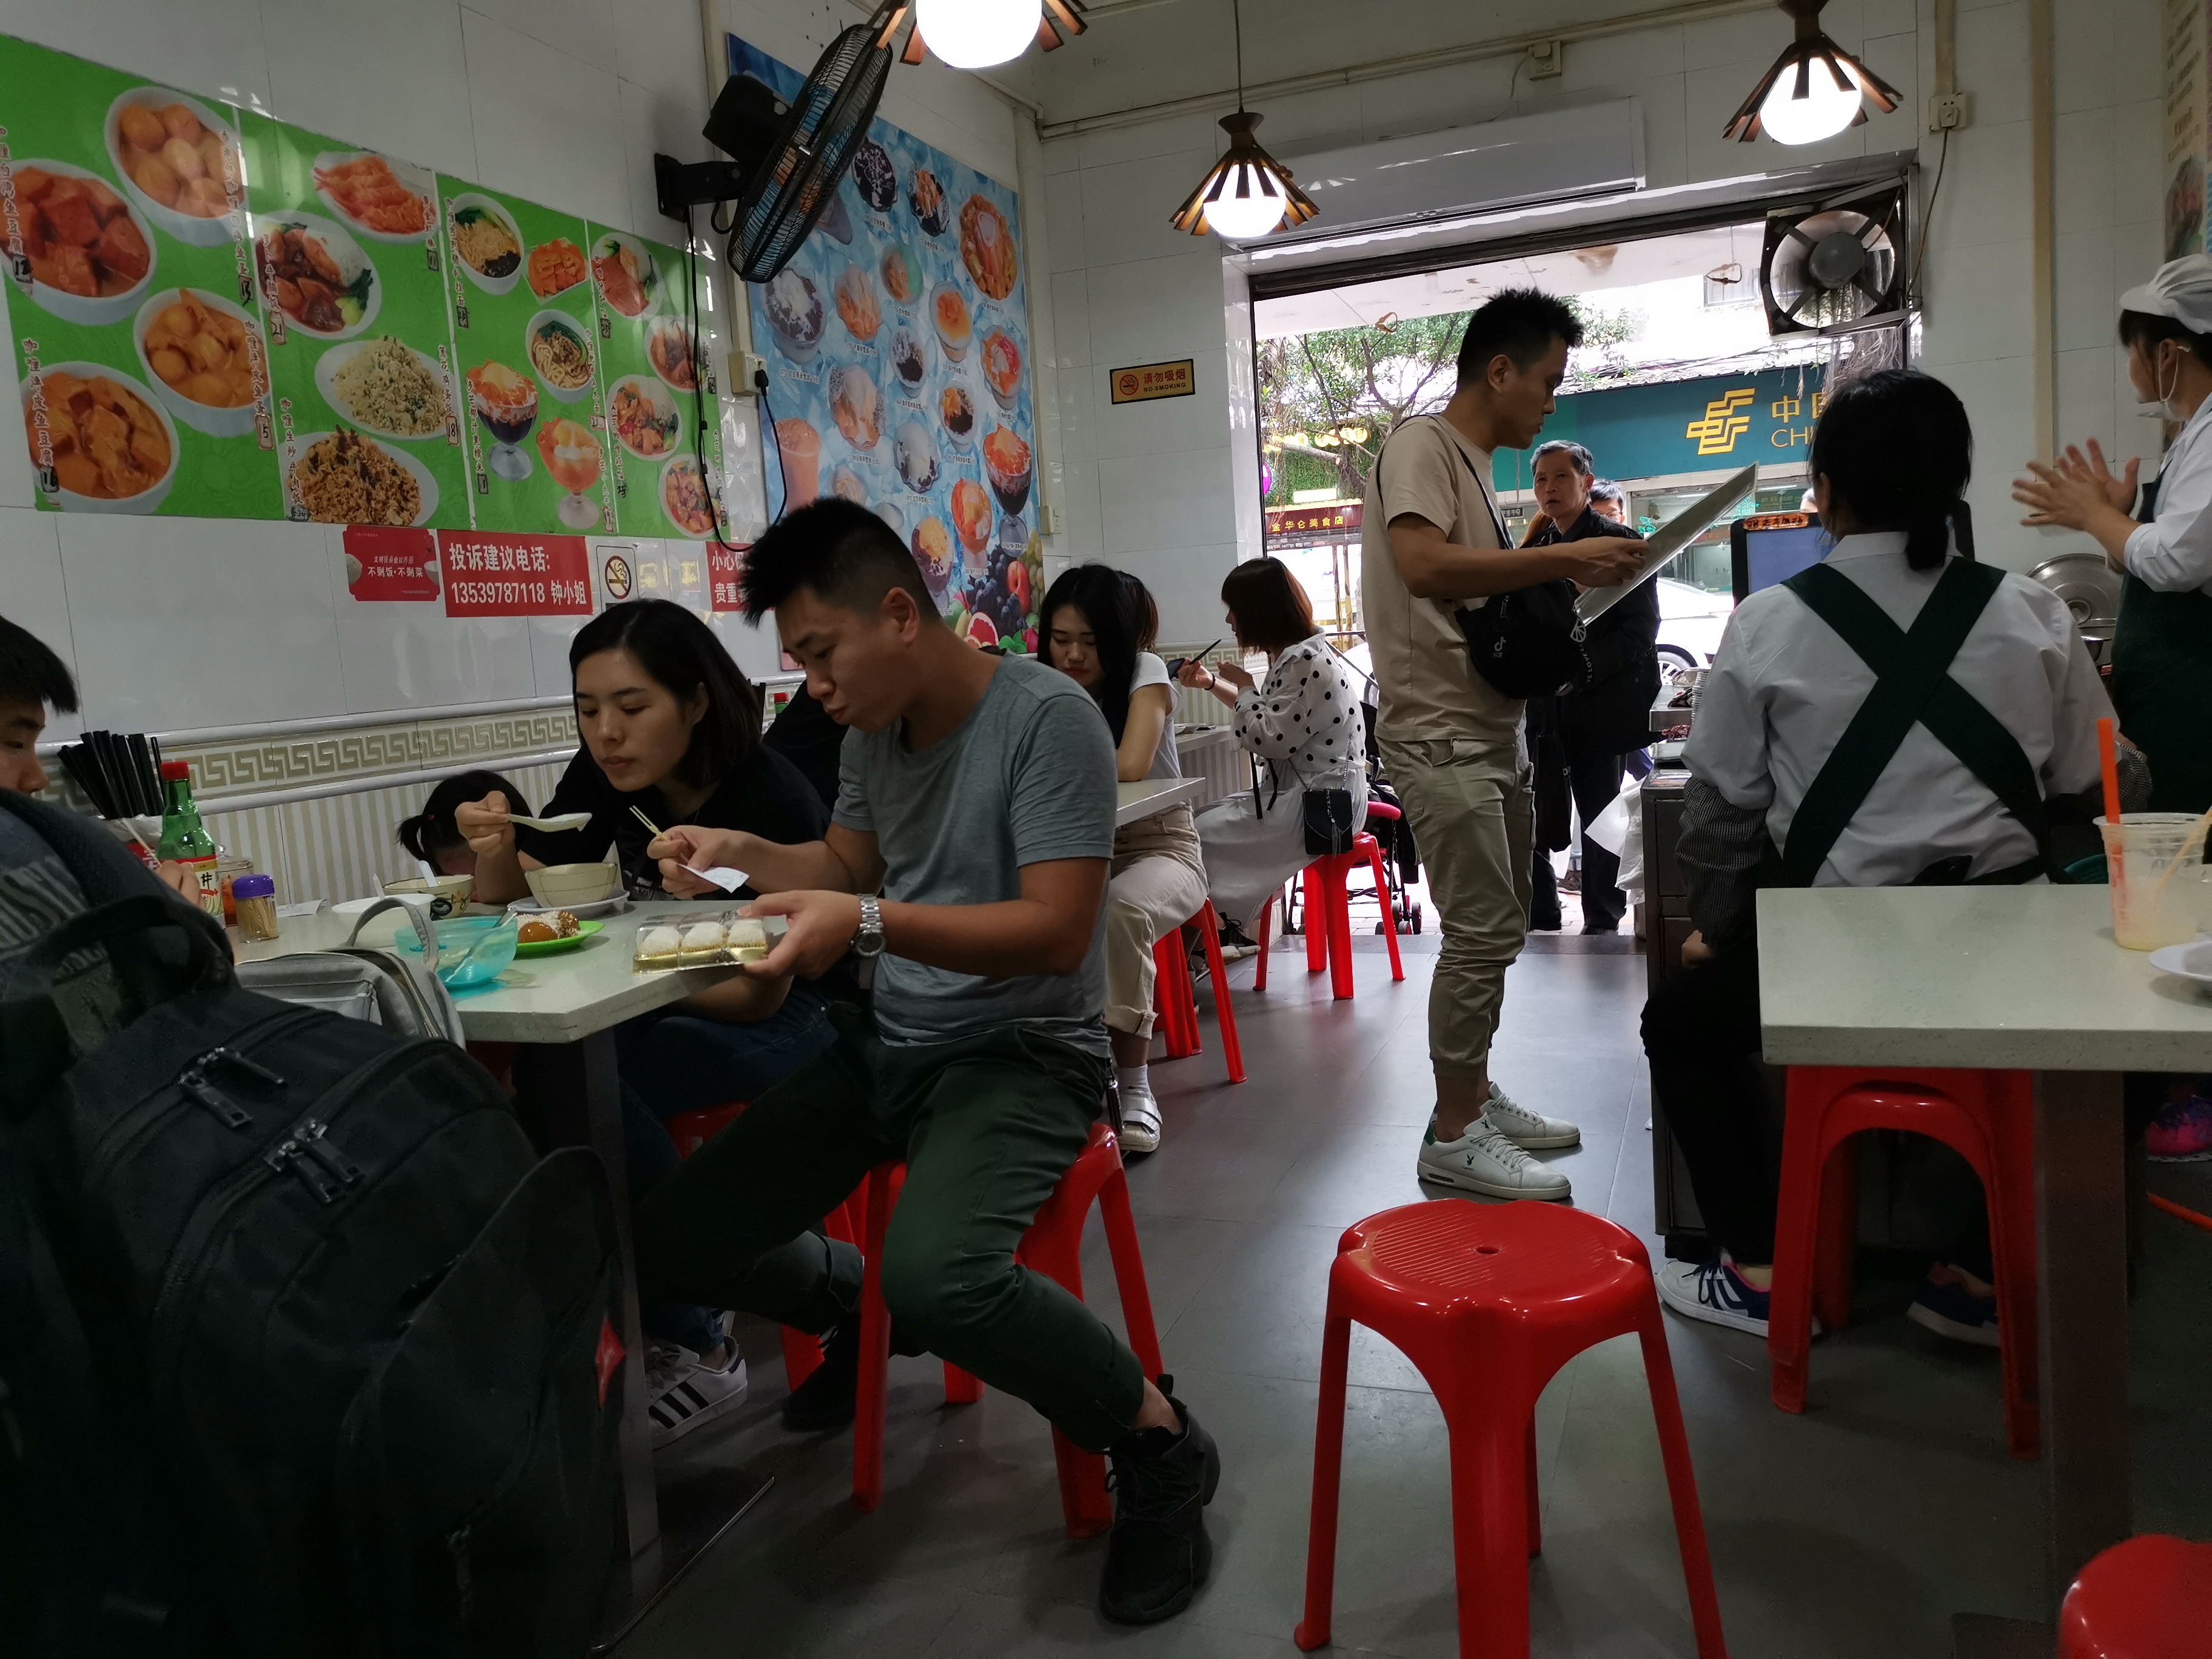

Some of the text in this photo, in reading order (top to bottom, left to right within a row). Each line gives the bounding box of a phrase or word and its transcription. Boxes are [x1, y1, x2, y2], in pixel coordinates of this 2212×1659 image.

[1144, 368, 1186, 384] 请勿吸烟
[1155, 382, 1186, 390] SMOKING
[258, 423, 269, 438] 15
[447, 423, 456, 438] 18
[280, 398, 304, 506] 咖喱生炒牛肉饭
[1272, 515, 1344, 532] 金华仑美食店
[451, 578, 587, 605] 13539787118 钟小姐
